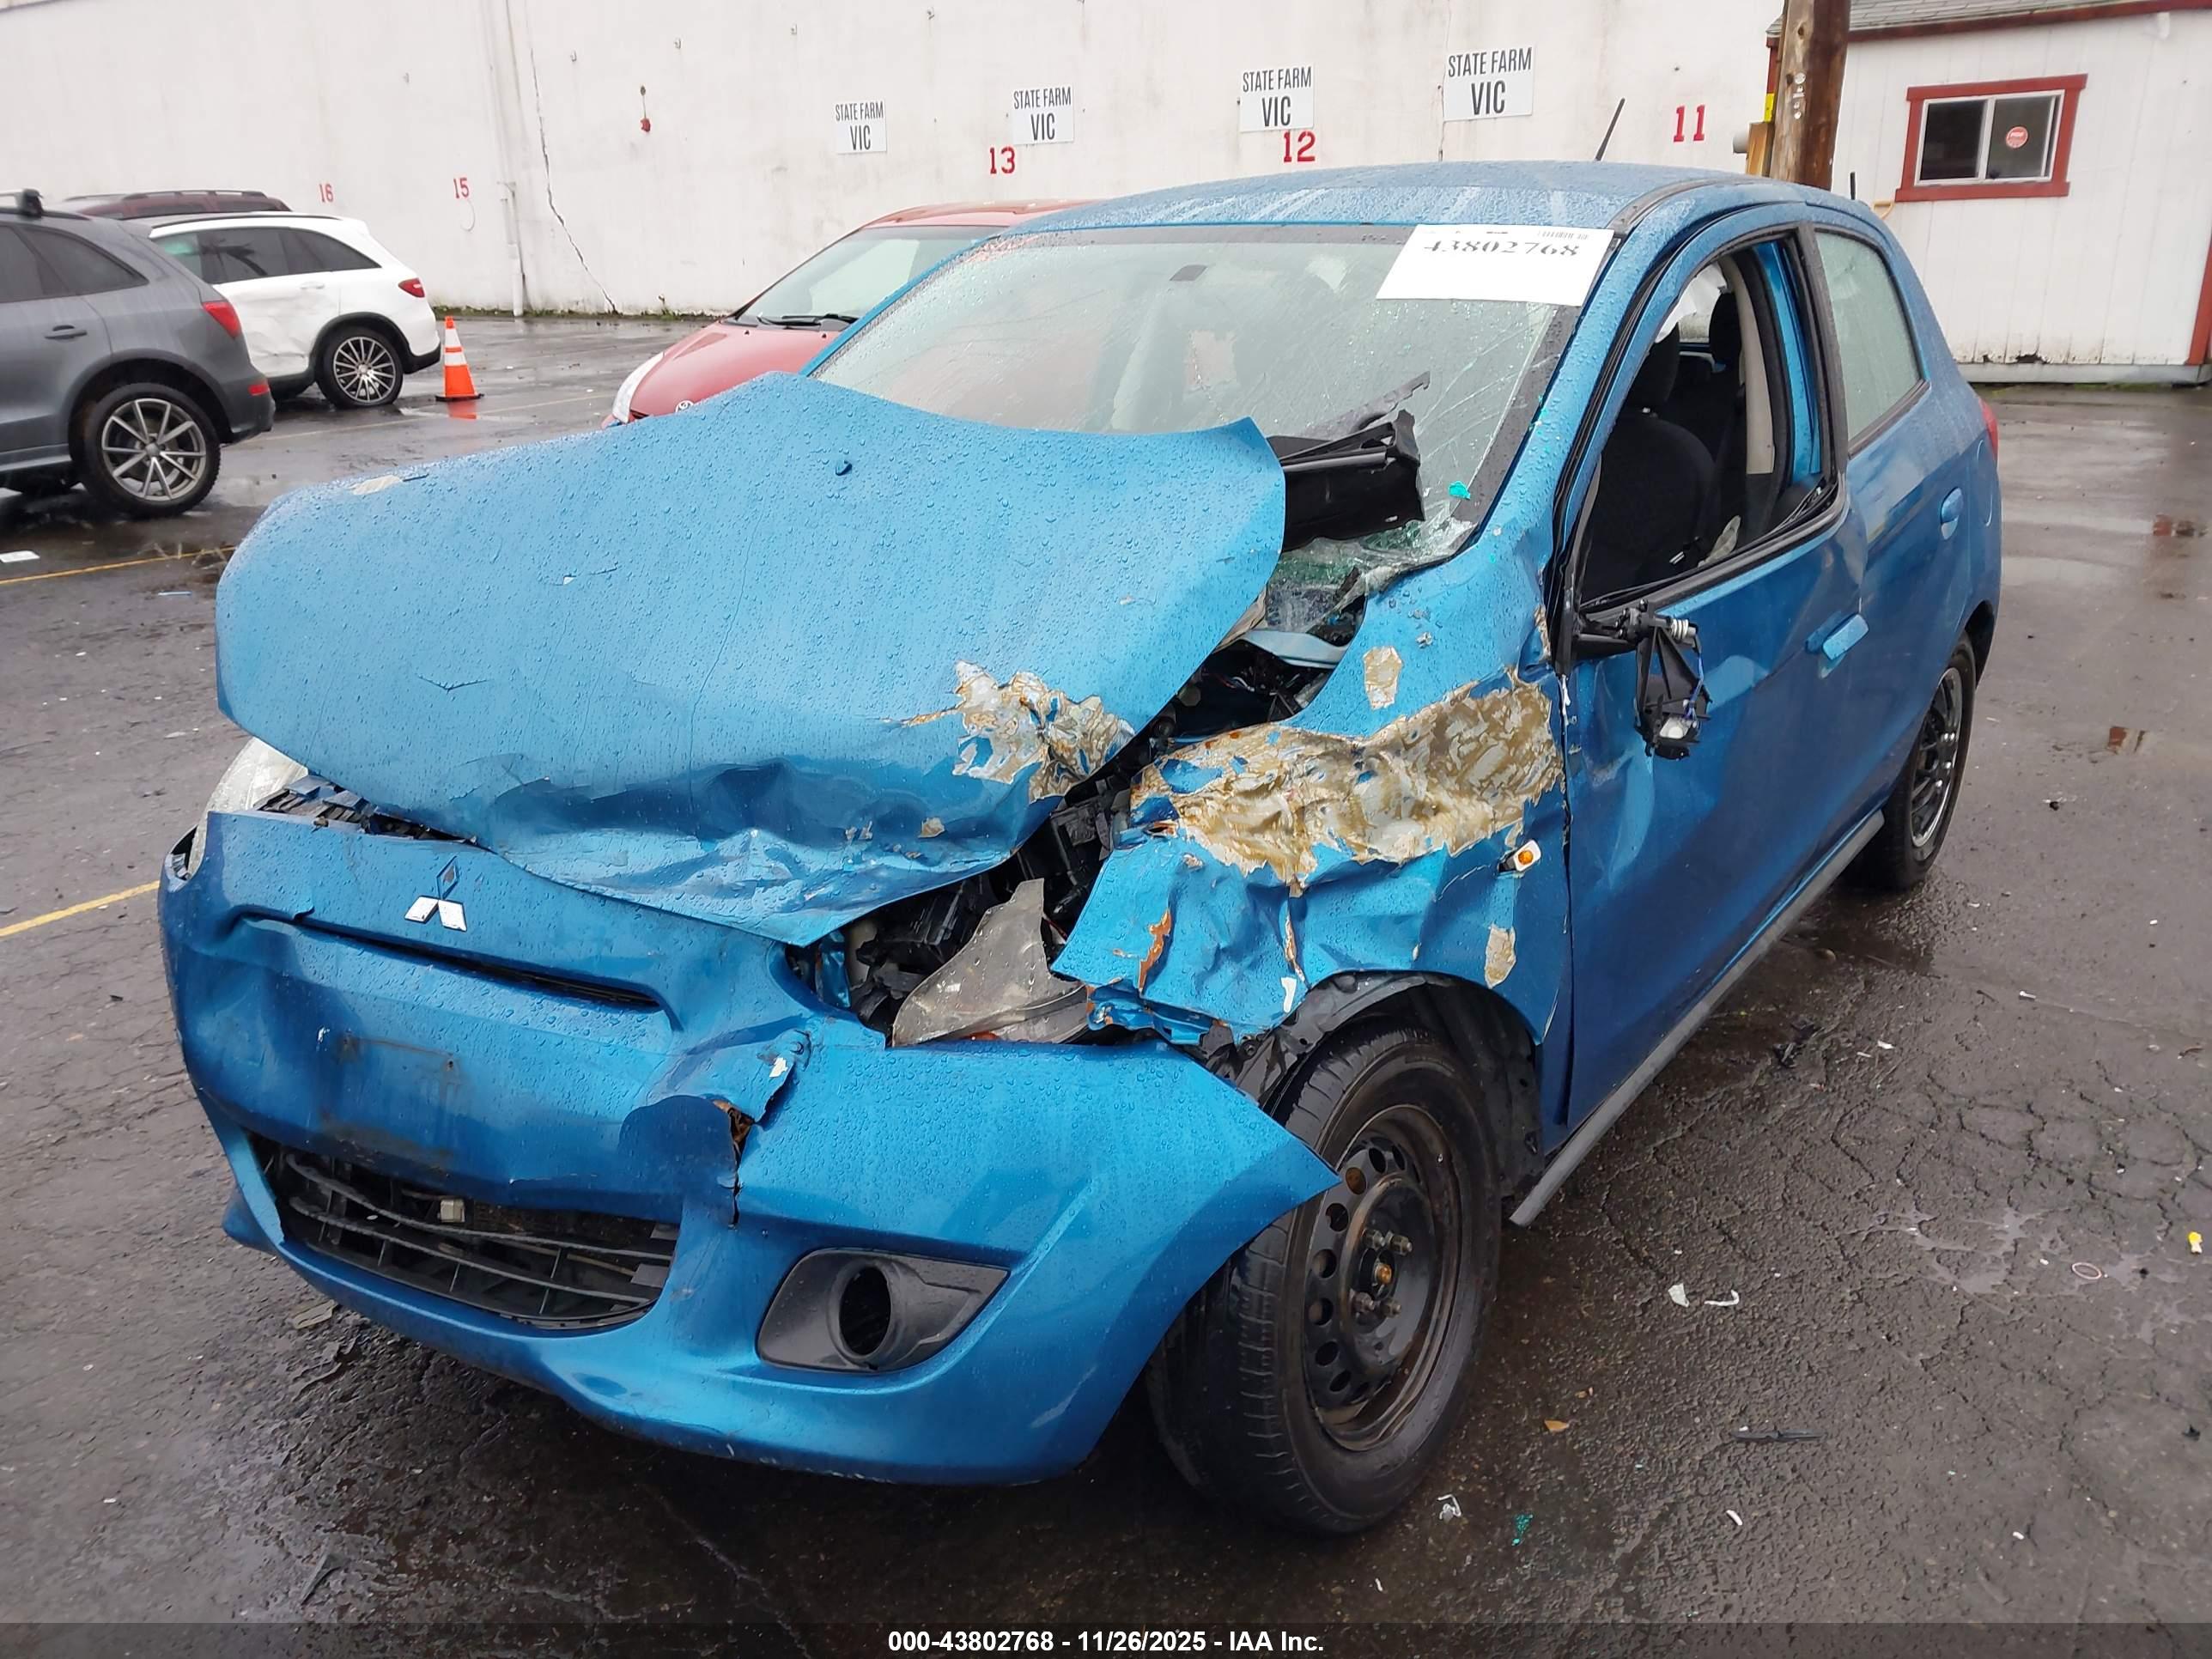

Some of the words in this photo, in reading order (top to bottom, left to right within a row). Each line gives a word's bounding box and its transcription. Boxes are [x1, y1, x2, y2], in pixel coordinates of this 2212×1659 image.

[1448, 52, 1487, 77] STATE
[1491, 46, 1533, 74] FARM
[1243, 70, 1274, 93] STATE
[1278, 66, 1312, 89] FARM
[835, 103, 858, 122] STATE
[860, 100, 884, 120] FARM
[1013, 88, 1041, 110] STATE
[1043, 86, 1072, 107] FARM
[1262, 95, 1291, 127] VIC
[1471, 80, 1506, 116] VIC
[849, 125, 871, 150] VIC
[1030, 112, 1055, 141] VIC
[1674, 105, 1705, 143] 11
[989, 146, 1016, 174] 13
[1283, 131, 1316, 163] 12
[319, 183, 334, 203] 16
[453, 177, 470, 199] 15
[1423, 238, 1582, 257] 43802768
